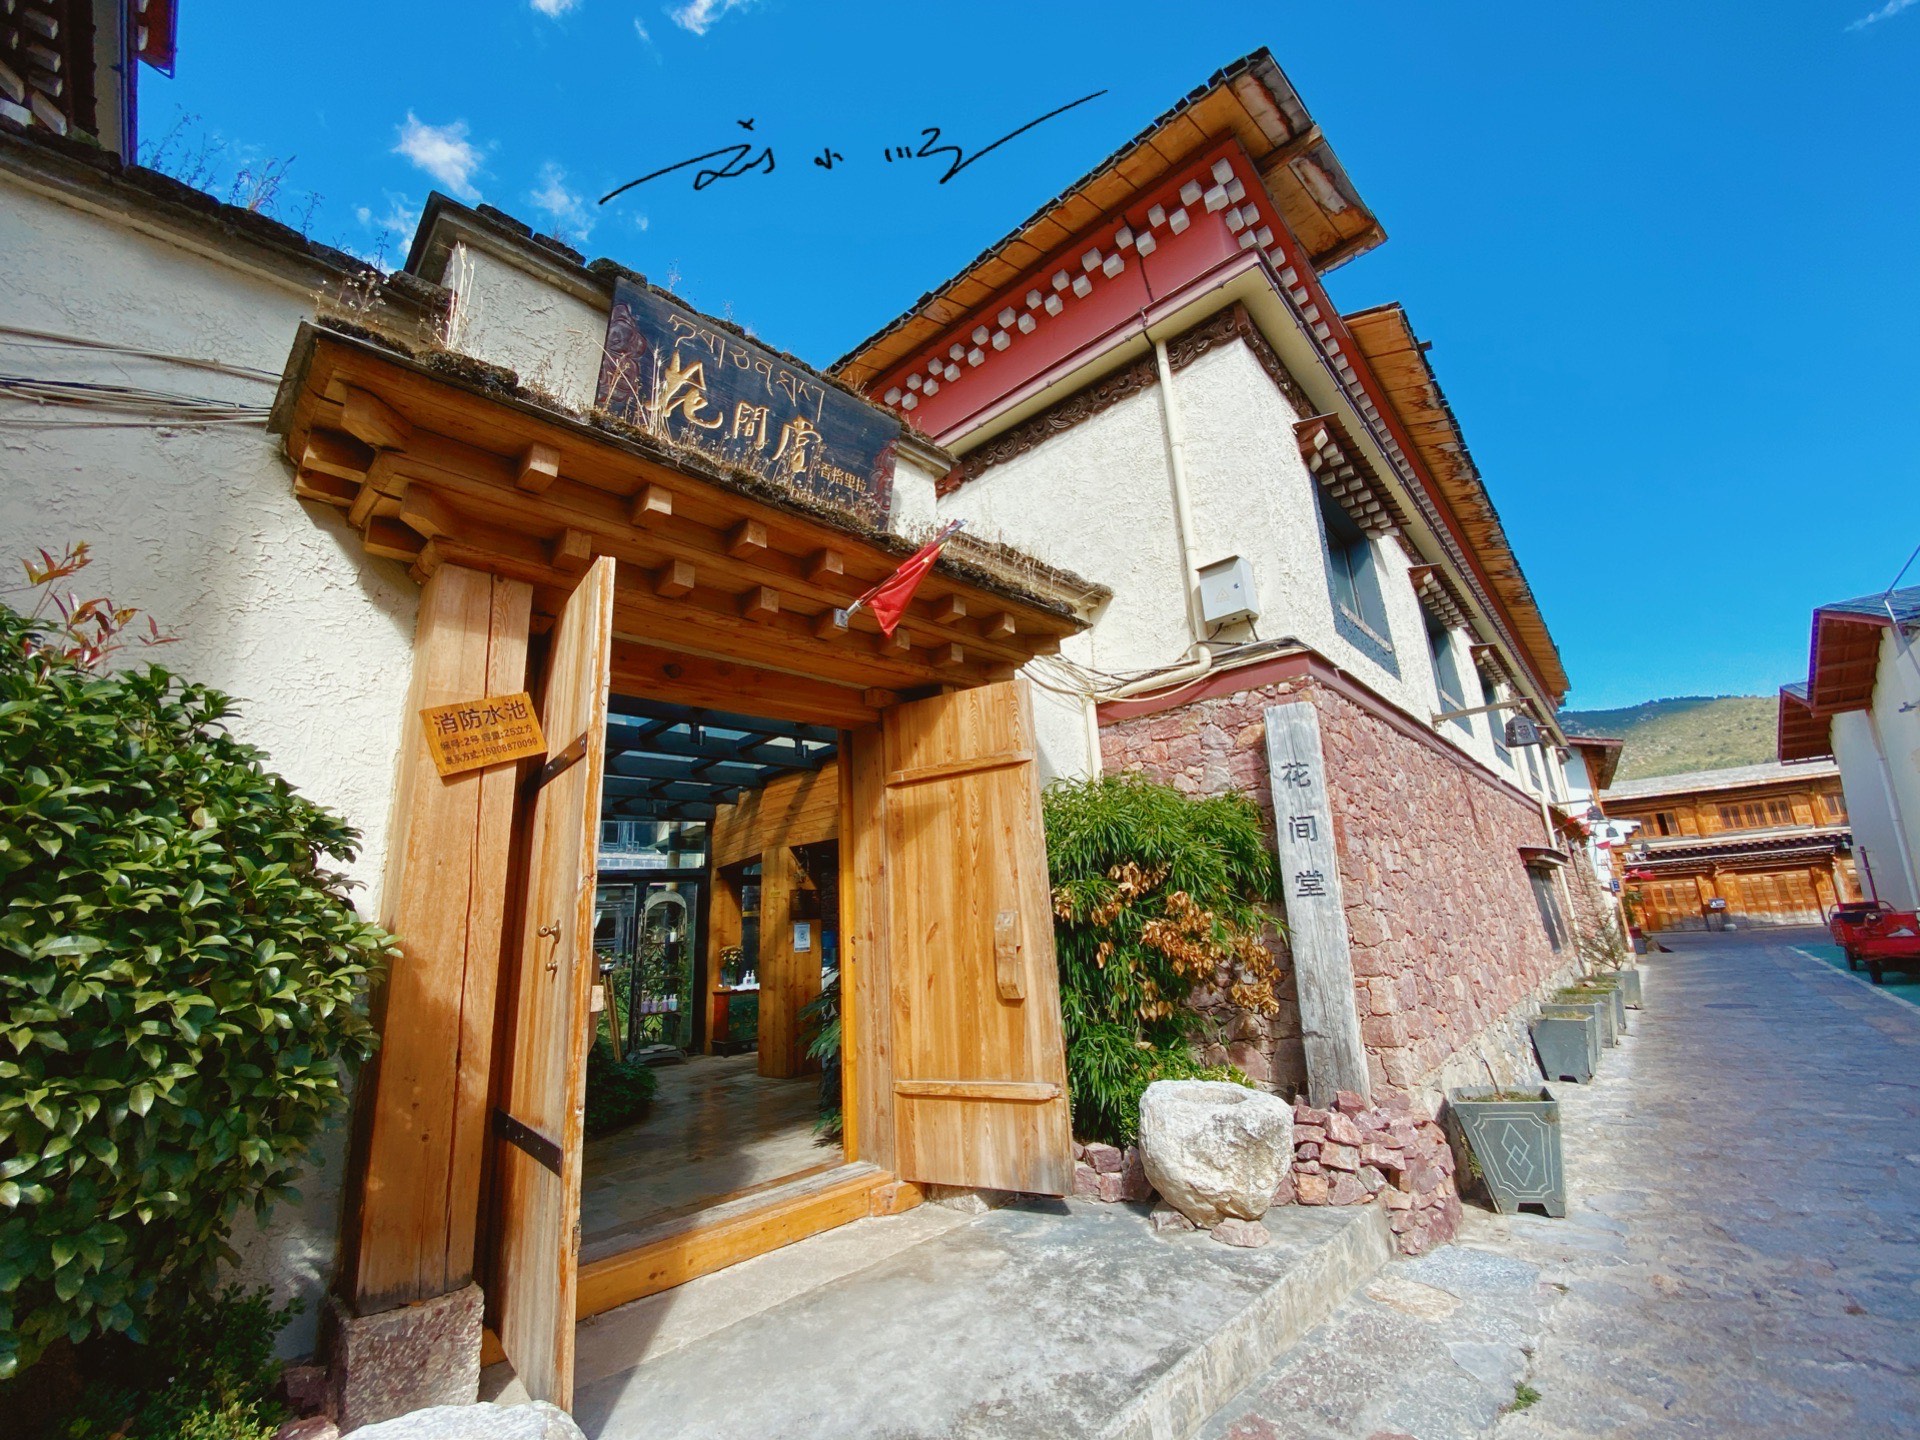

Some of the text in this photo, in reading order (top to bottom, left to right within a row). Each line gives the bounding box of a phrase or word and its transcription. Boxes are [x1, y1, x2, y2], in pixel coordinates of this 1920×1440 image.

[820, 462, 867, 493] 香格里拉
[432, 699, 529, 737] 消防水池
[1281, 762, 1326, 898] 花间堂
